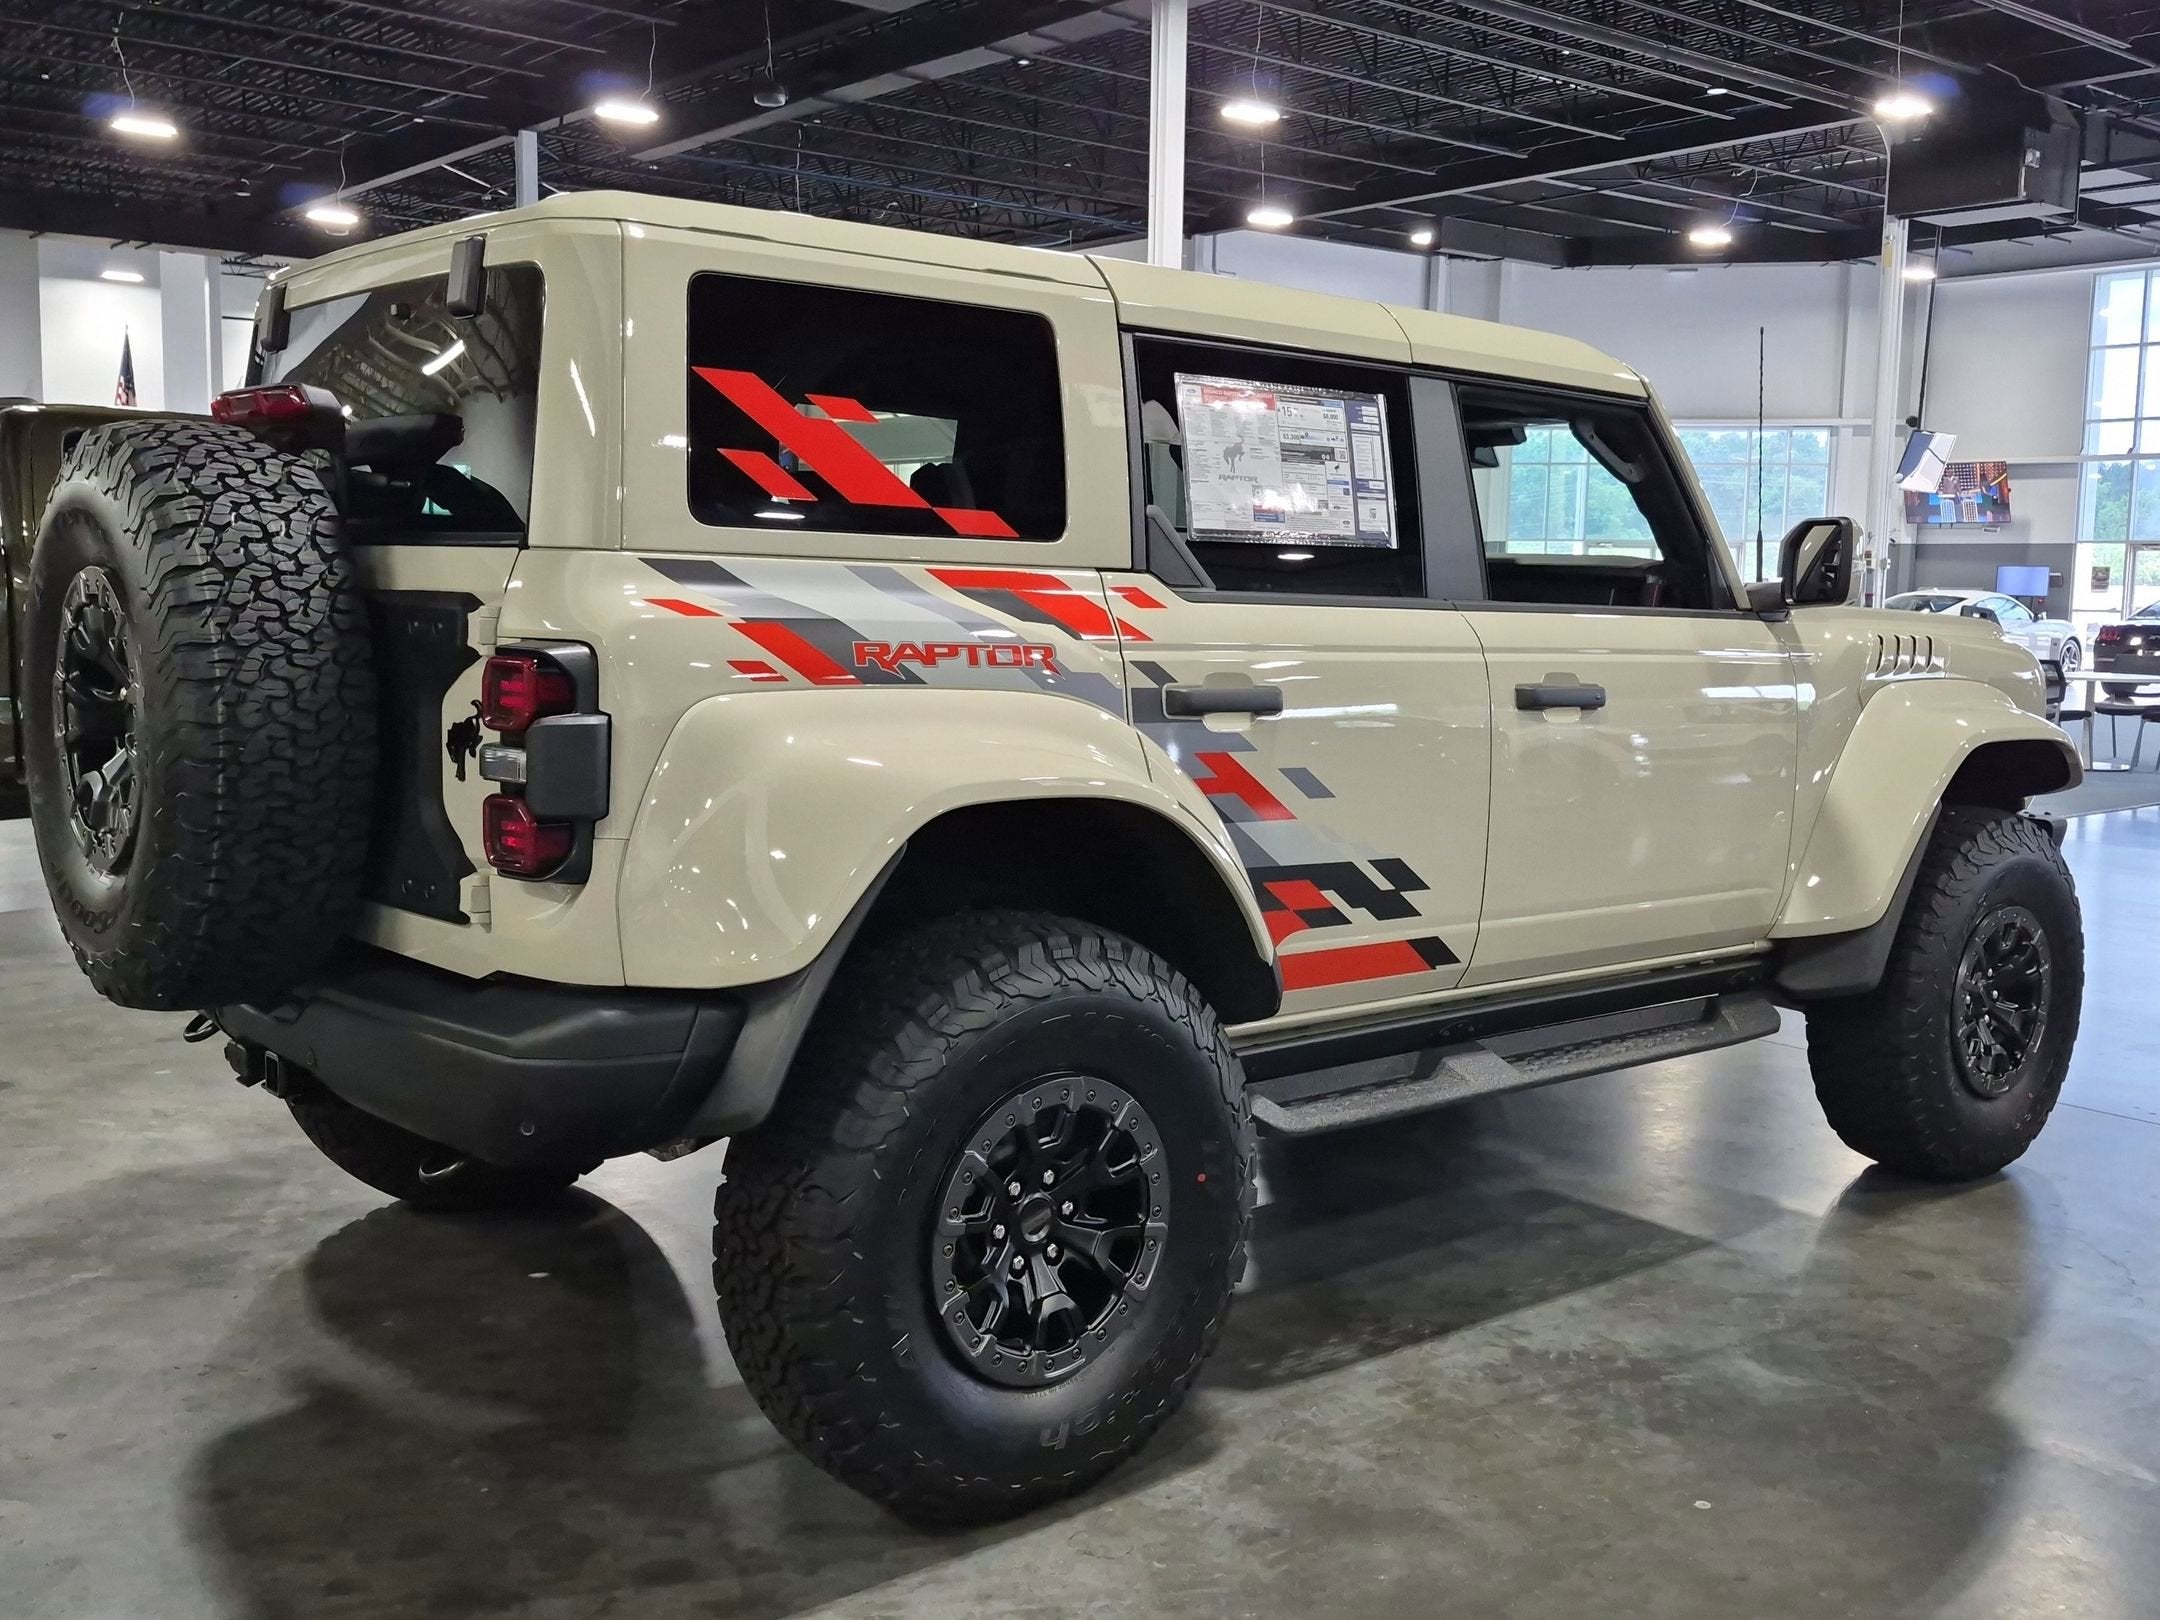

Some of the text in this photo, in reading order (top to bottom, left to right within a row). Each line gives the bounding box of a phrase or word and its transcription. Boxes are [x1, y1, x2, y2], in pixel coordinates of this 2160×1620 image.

[1281, 405, 1293, 417] 15
[1218, 473, 1258, 483] RAPTOR
[852, 640, 1066, 681] RAPTOR
